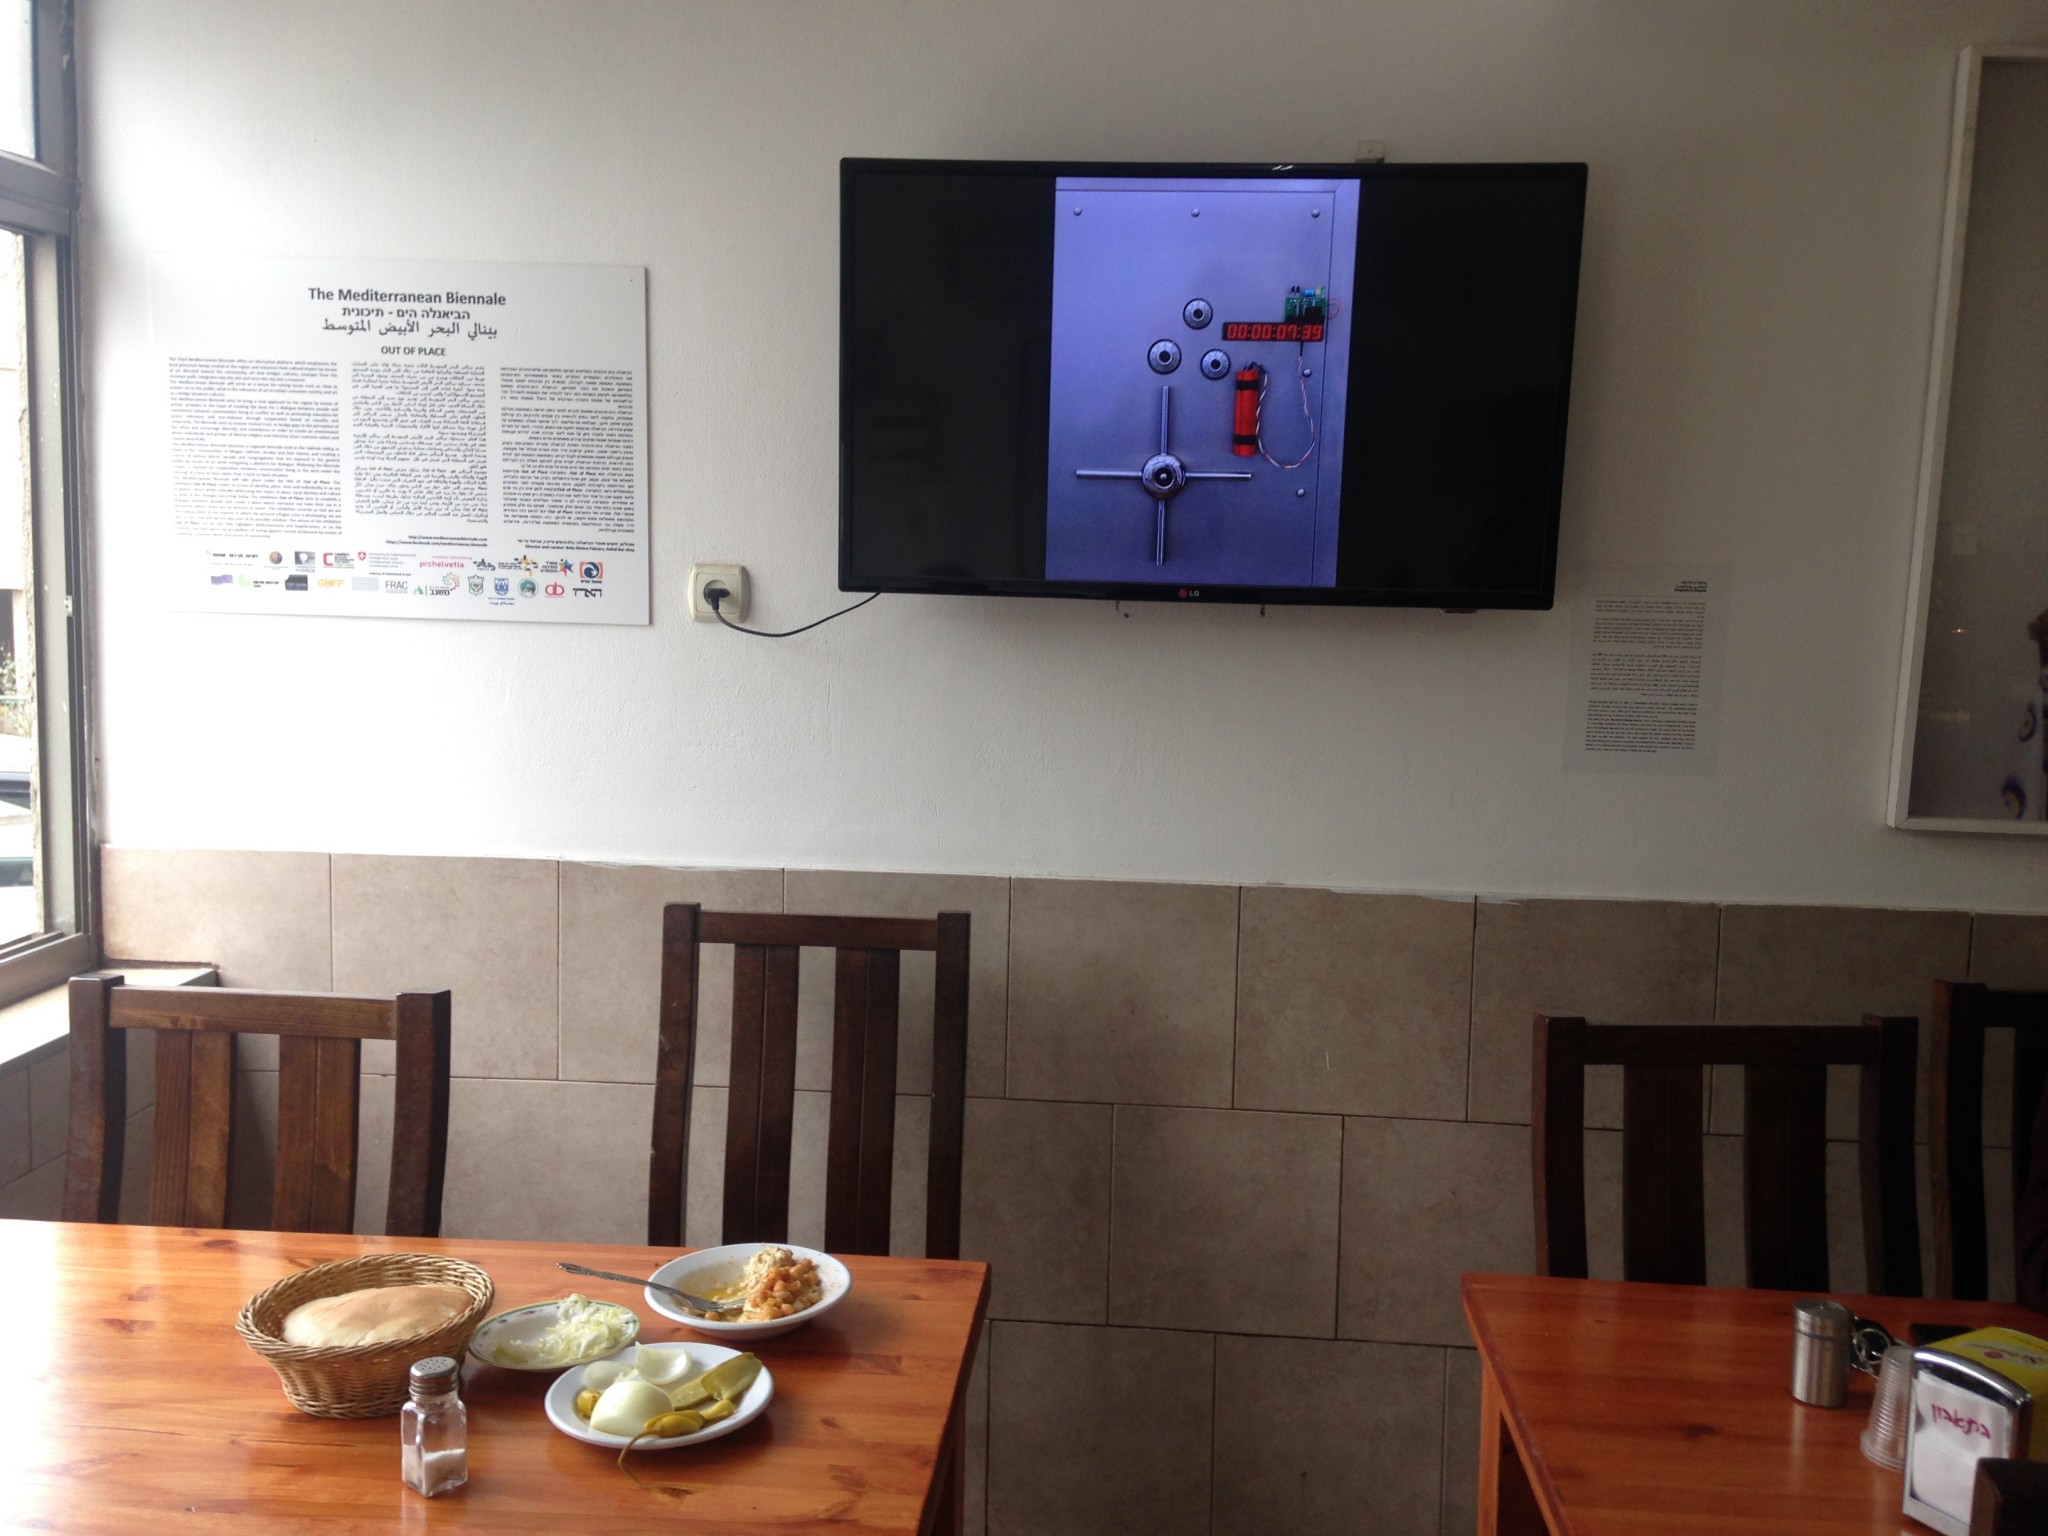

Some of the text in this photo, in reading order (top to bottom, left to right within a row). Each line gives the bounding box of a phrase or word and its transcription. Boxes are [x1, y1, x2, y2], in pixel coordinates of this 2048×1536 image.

[308, 288, 507, 306] The Mediterranean Biennale
[342, 306, 384, 317] תיכונית
[397, 308, 417, 319] הים
[421, 309, 471, 320] הביאנלה
[322, 319, 498, 341] بينالي البحر الأبيض المتوسط
[381, 346, 447, 357] OUT OF PLACE
[385, 581, 409, 590] FRAC
